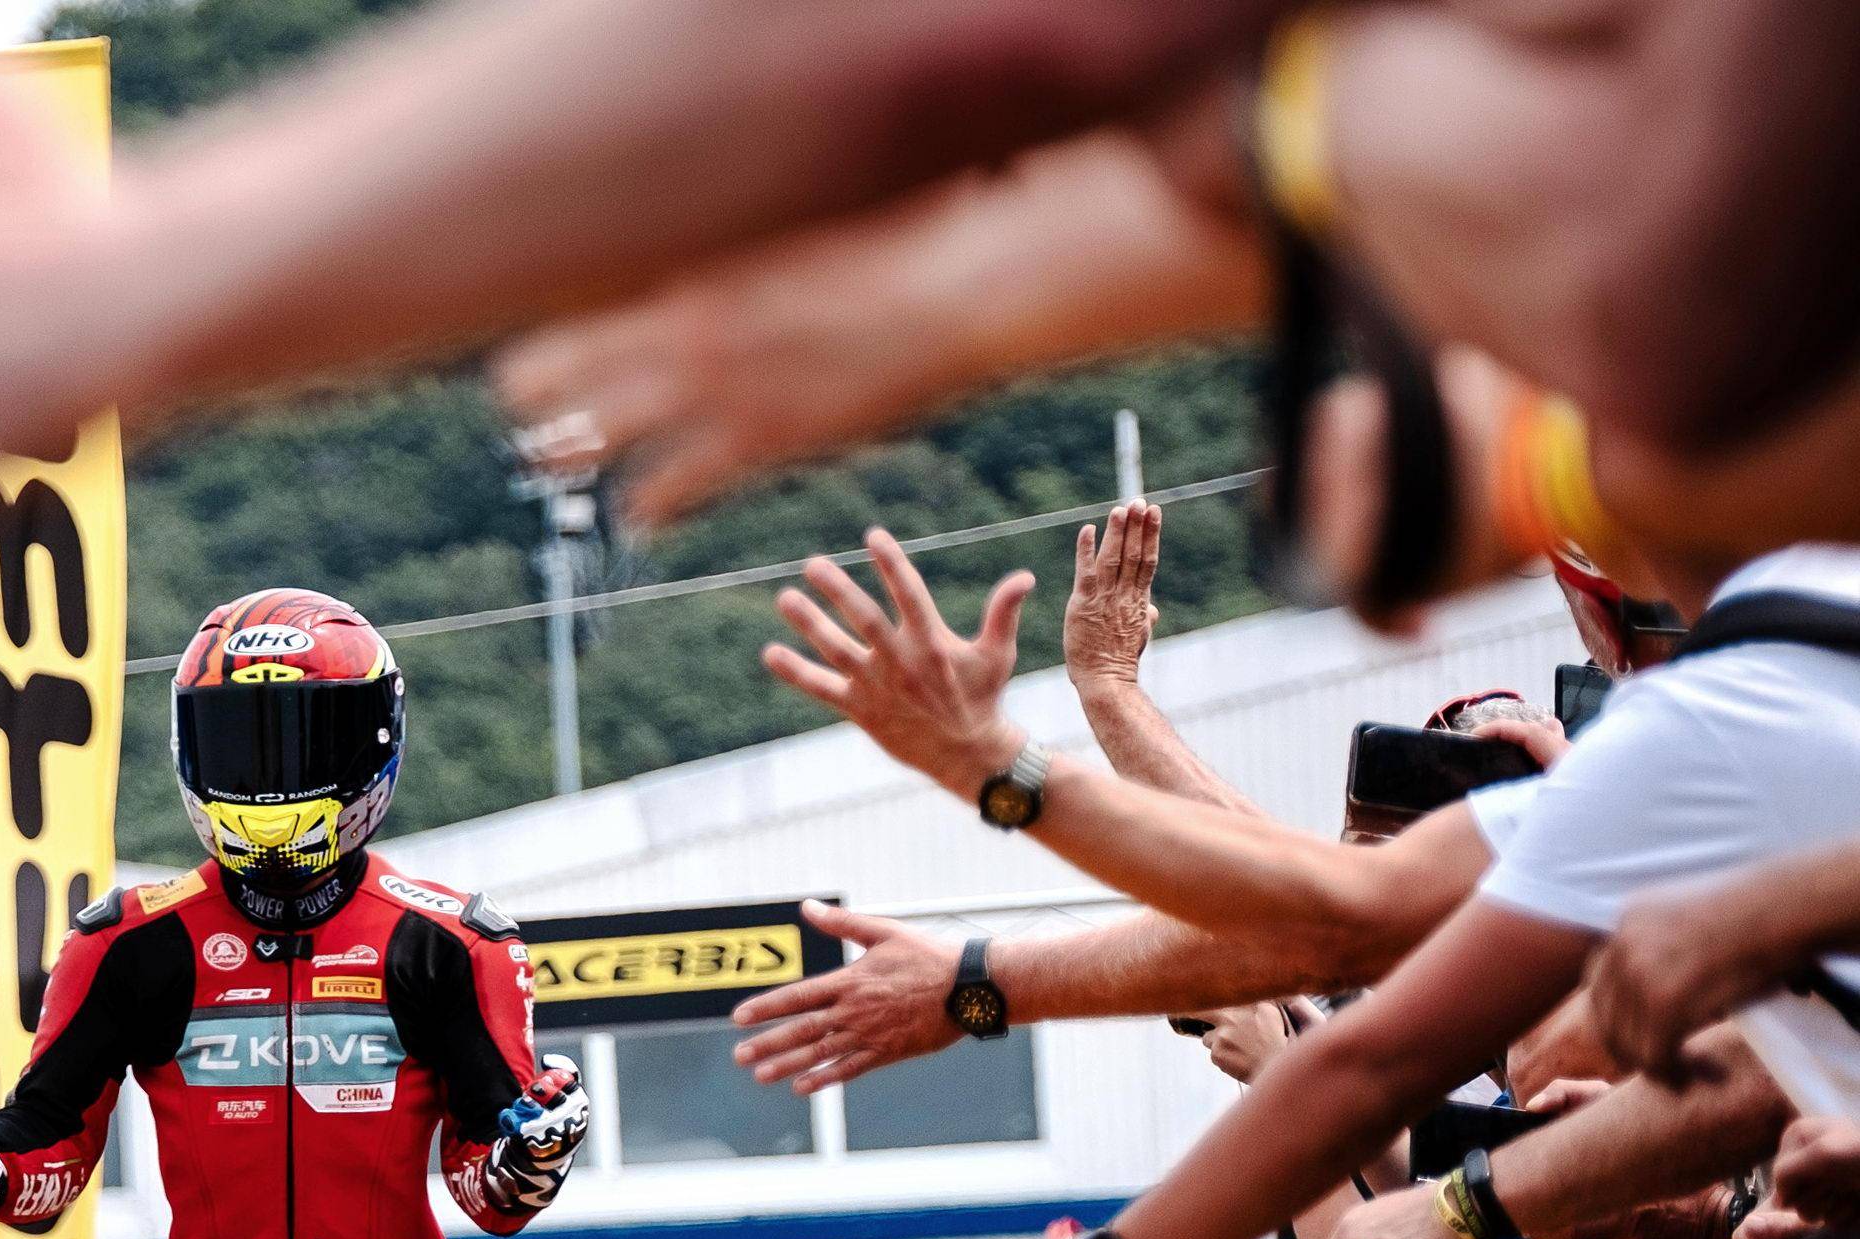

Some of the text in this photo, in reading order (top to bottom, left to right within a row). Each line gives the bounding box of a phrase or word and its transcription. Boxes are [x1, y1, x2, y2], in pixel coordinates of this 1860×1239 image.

[288, 783, 338, 800] RANDOM
[296, 878, 343, 917] POWER
[318, 981, 376, 994] PIRELLI
[249, 1033, 389, 1068] KOVE
[336, 1087, 383, 1102] CHINA
